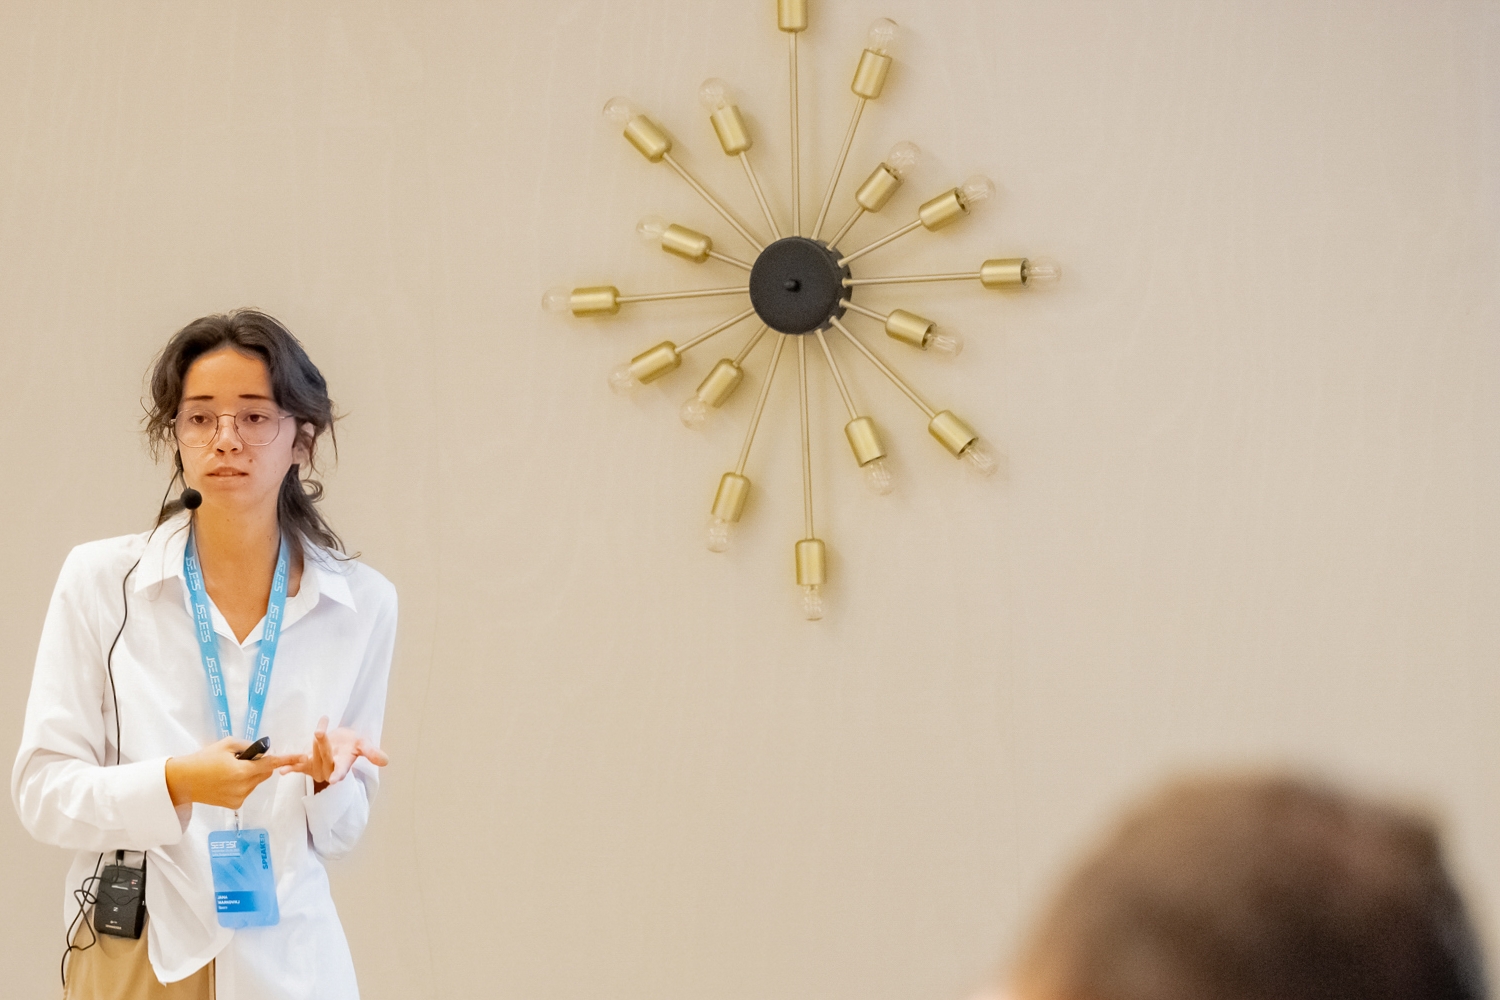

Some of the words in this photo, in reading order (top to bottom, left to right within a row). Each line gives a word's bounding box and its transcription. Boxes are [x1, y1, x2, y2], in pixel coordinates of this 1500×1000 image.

[196, 603, 211, 643] SEETEST
[265, 603, 279, 642] SEETEST
[206, 657, 222, 696] SEETEST
[255, 654, 270, 695] SEETEST
[260, 833, 268, 870] SPEAKER
